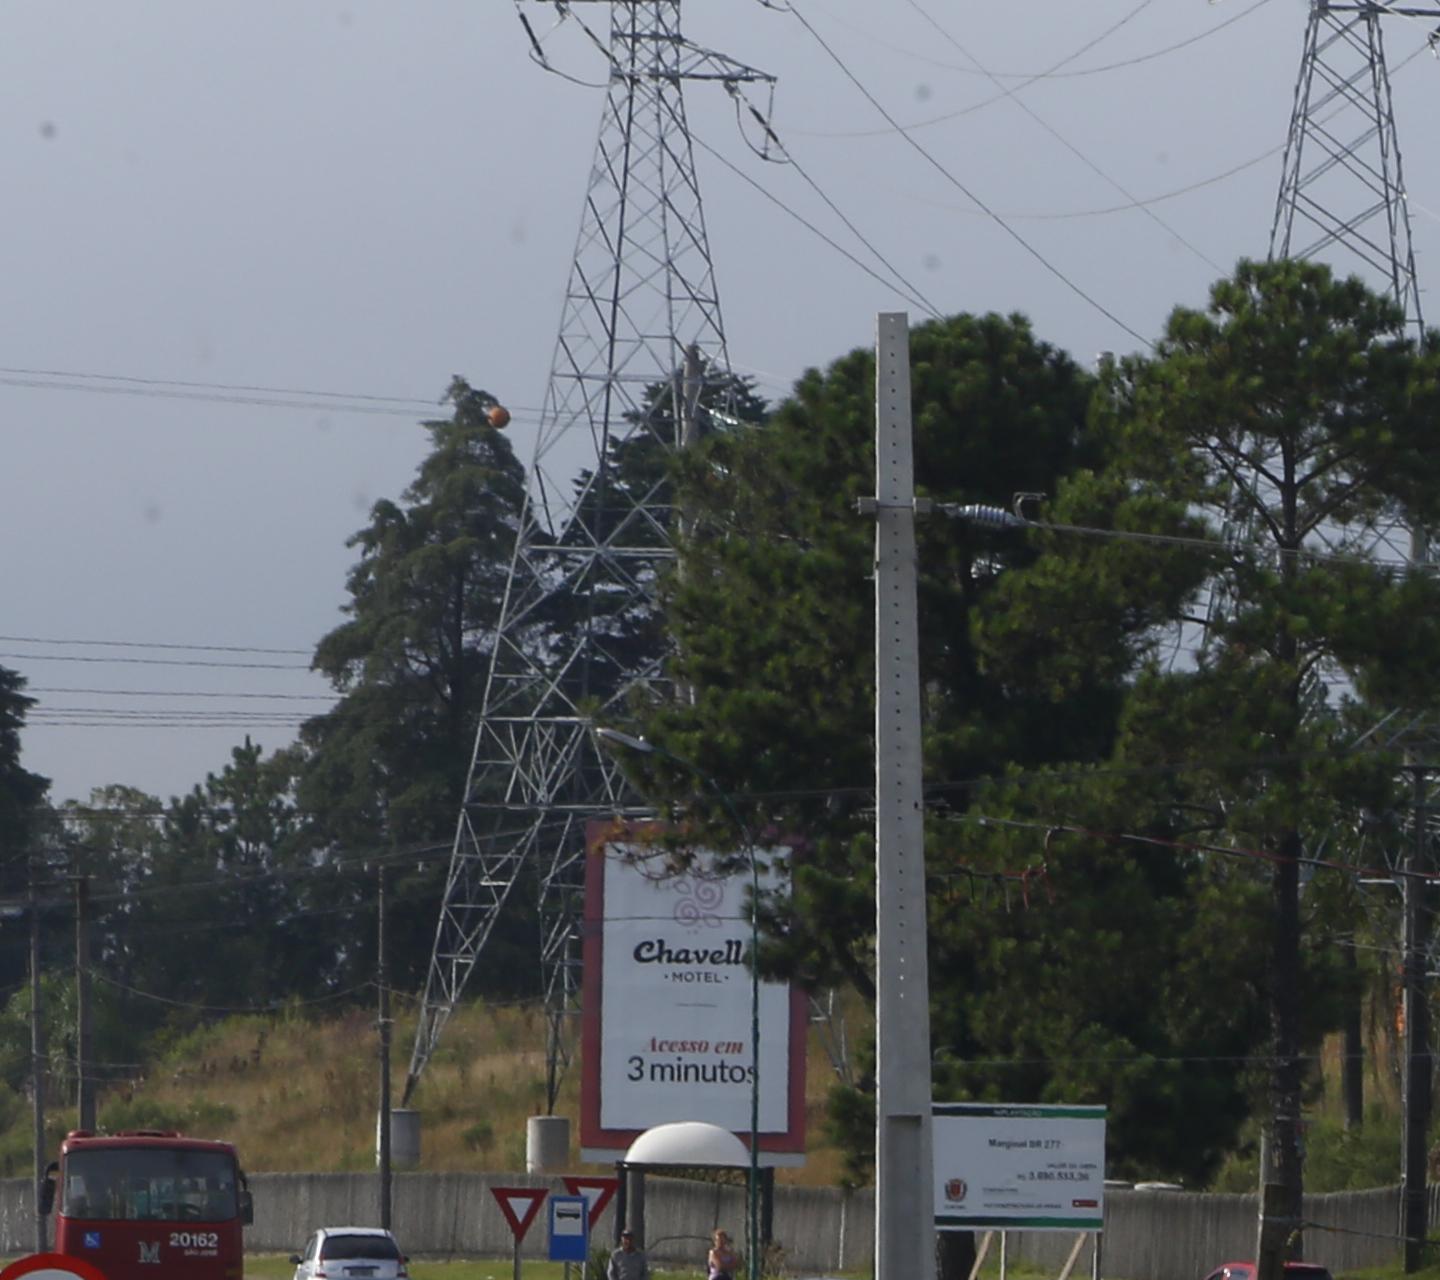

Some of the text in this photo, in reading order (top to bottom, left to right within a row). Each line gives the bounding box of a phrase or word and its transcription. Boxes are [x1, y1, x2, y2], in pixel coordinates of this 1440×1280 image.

[633, 939, 758, 966] Chavell
[672, 972, 722, 983] MOTEL
[643, 1036, 744, 1054] Acesso em
[627, 1055, 758, 1084] 3 minutos
[169, 1233, 218, 1247] 20162
